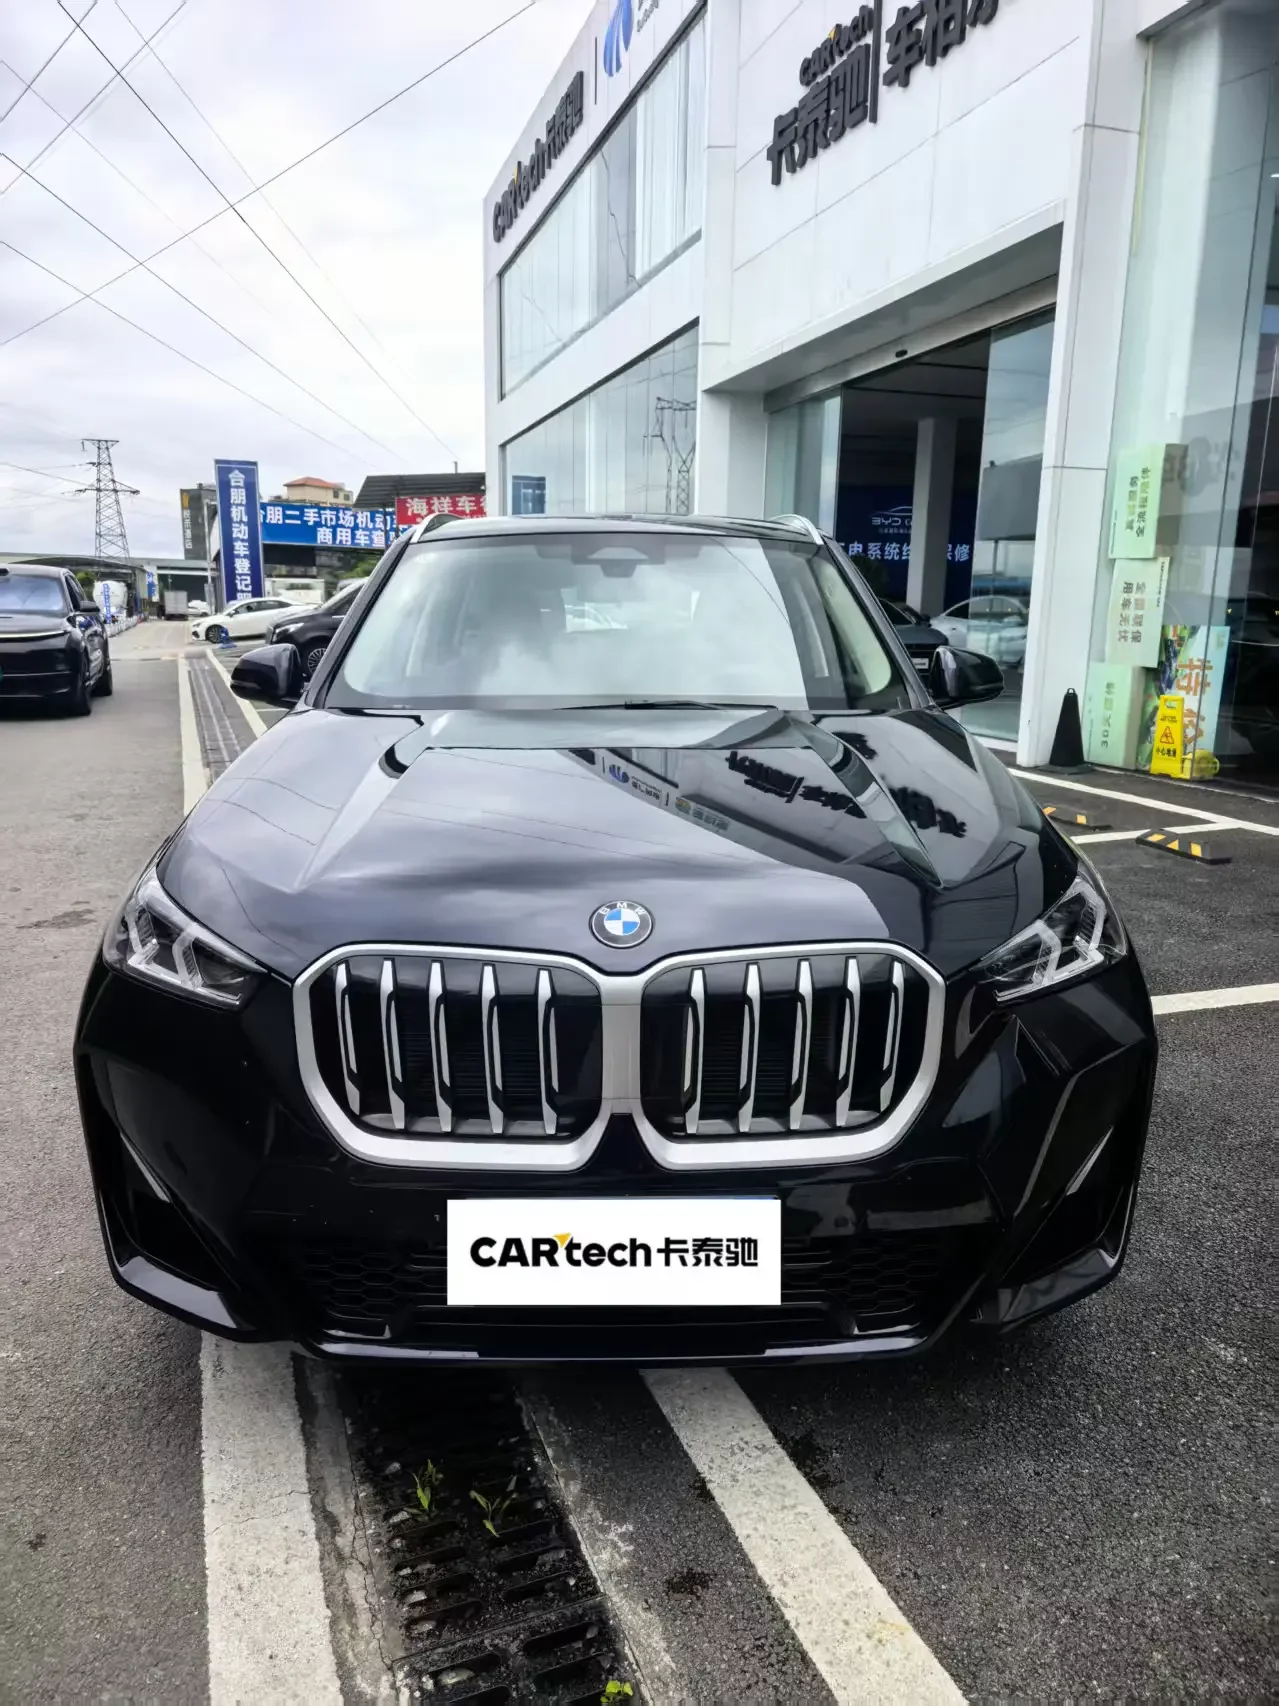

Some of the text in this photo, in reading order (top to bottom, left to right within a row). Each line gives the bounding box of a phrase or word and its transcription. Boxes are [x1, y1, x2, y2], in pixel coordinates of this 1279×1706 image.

[799, 5, 874, 87] CARtech
[767, 43, 871, 186] 卡泰驰
[260, 506, 398, 530] 朋二手市场机动
[406, 496, 487, 517] 海祥车
